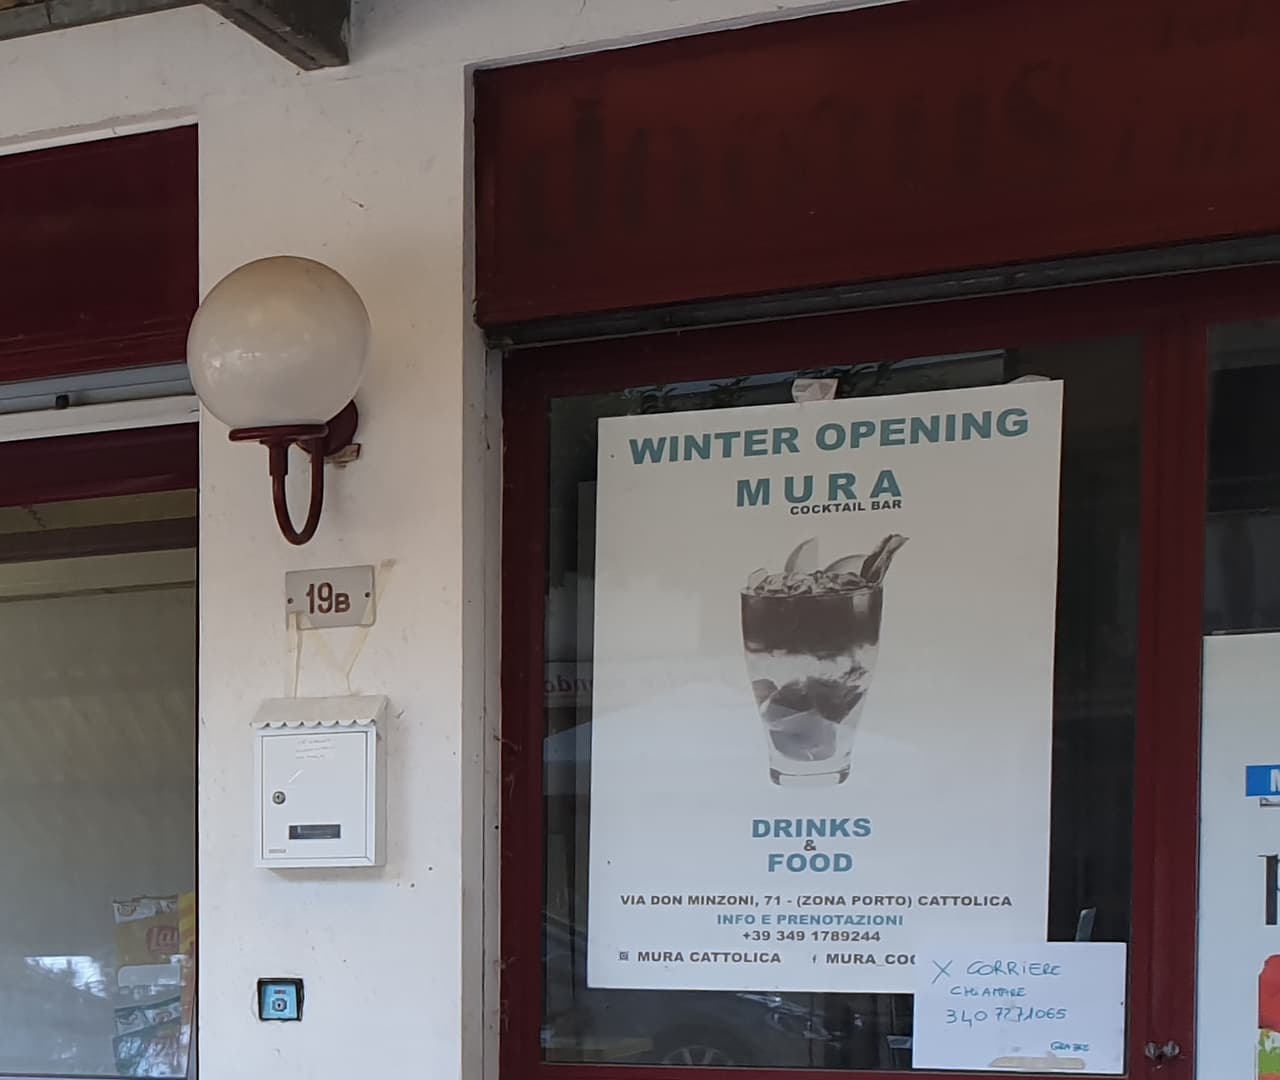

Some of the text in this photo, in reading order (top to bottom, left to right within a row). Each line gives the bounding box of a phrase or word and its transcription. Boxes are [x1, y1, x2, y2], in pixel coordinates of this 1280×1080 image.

[629, 407, 1029, 465] WINTER OPENING
[736, 469, 902, 507] MURA
[789, 499, 902, 516] COCKTAIL BAR
[304, 582, 351, 615] 19B
[751, 817, 872, 838] DRINKS
[803, 839, 817, 852] &
[768, 853, 853, 873] FOOD
[620, 895, 647, 906] VIA
[650, 895, 683, 906] DON
[687, 895, 759, 908] MINZONI,
[764, 895, 782, 906] 71
[796, 894, 847, 908] (ZONA
[852, 894, 913, 908] PORTO)
[918, 895, 1012, 907] CATTOLICA
[717, 914, 904, 926] INFO E PRENOTAZIONI
[742, 930, 881, 942] +39 349 1789244
[637, 951, 781, 964] MURA CATTOLICA
[932, 960, 953, 984] X
[946, 1009, 988, 1028] 340
